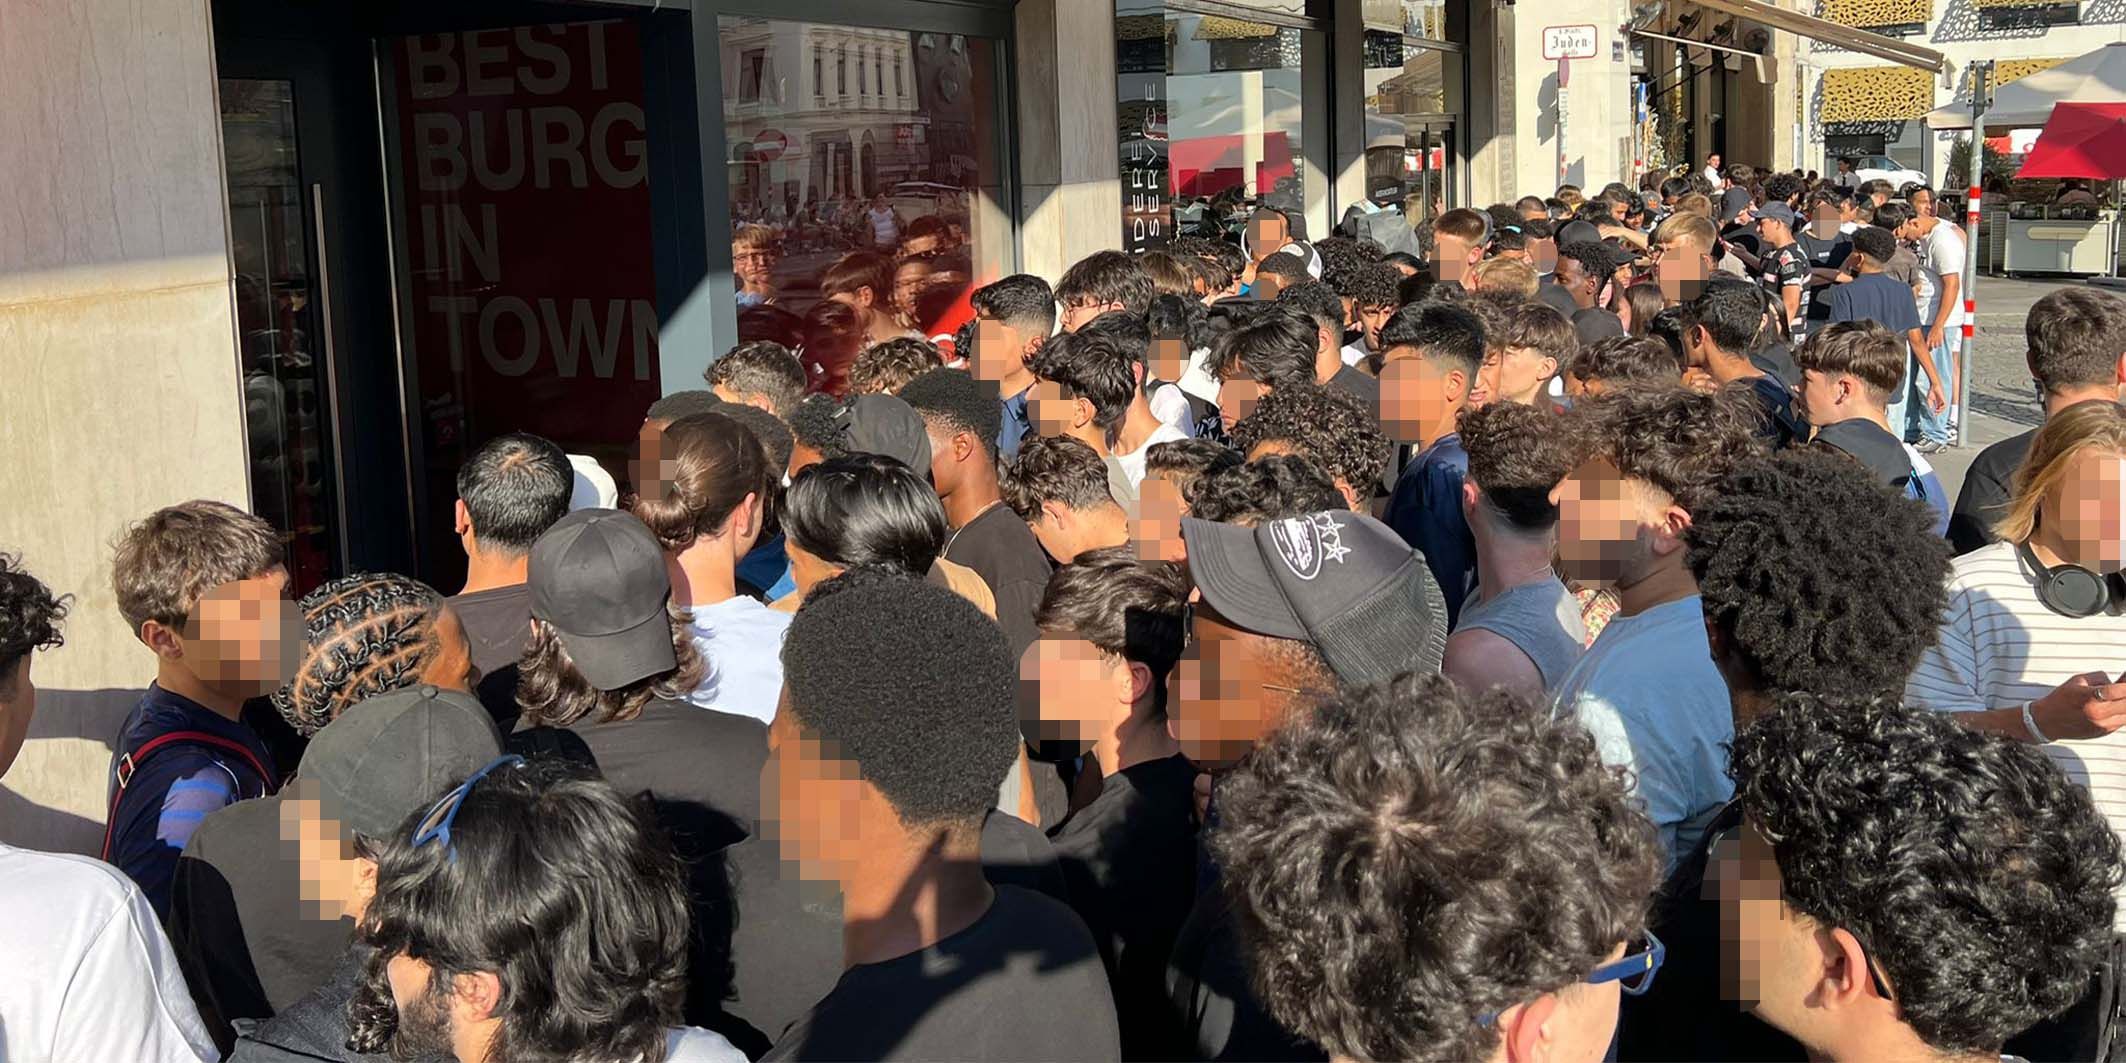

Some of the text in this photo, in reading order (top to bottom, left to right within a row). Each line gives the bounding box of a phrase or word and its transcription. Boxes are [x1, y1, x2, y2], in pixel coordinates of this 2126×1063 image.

[406, 22, 610, 99] BEST
[414, 102, 649, 191] BURG
[421, 203, 501, 282] IN
